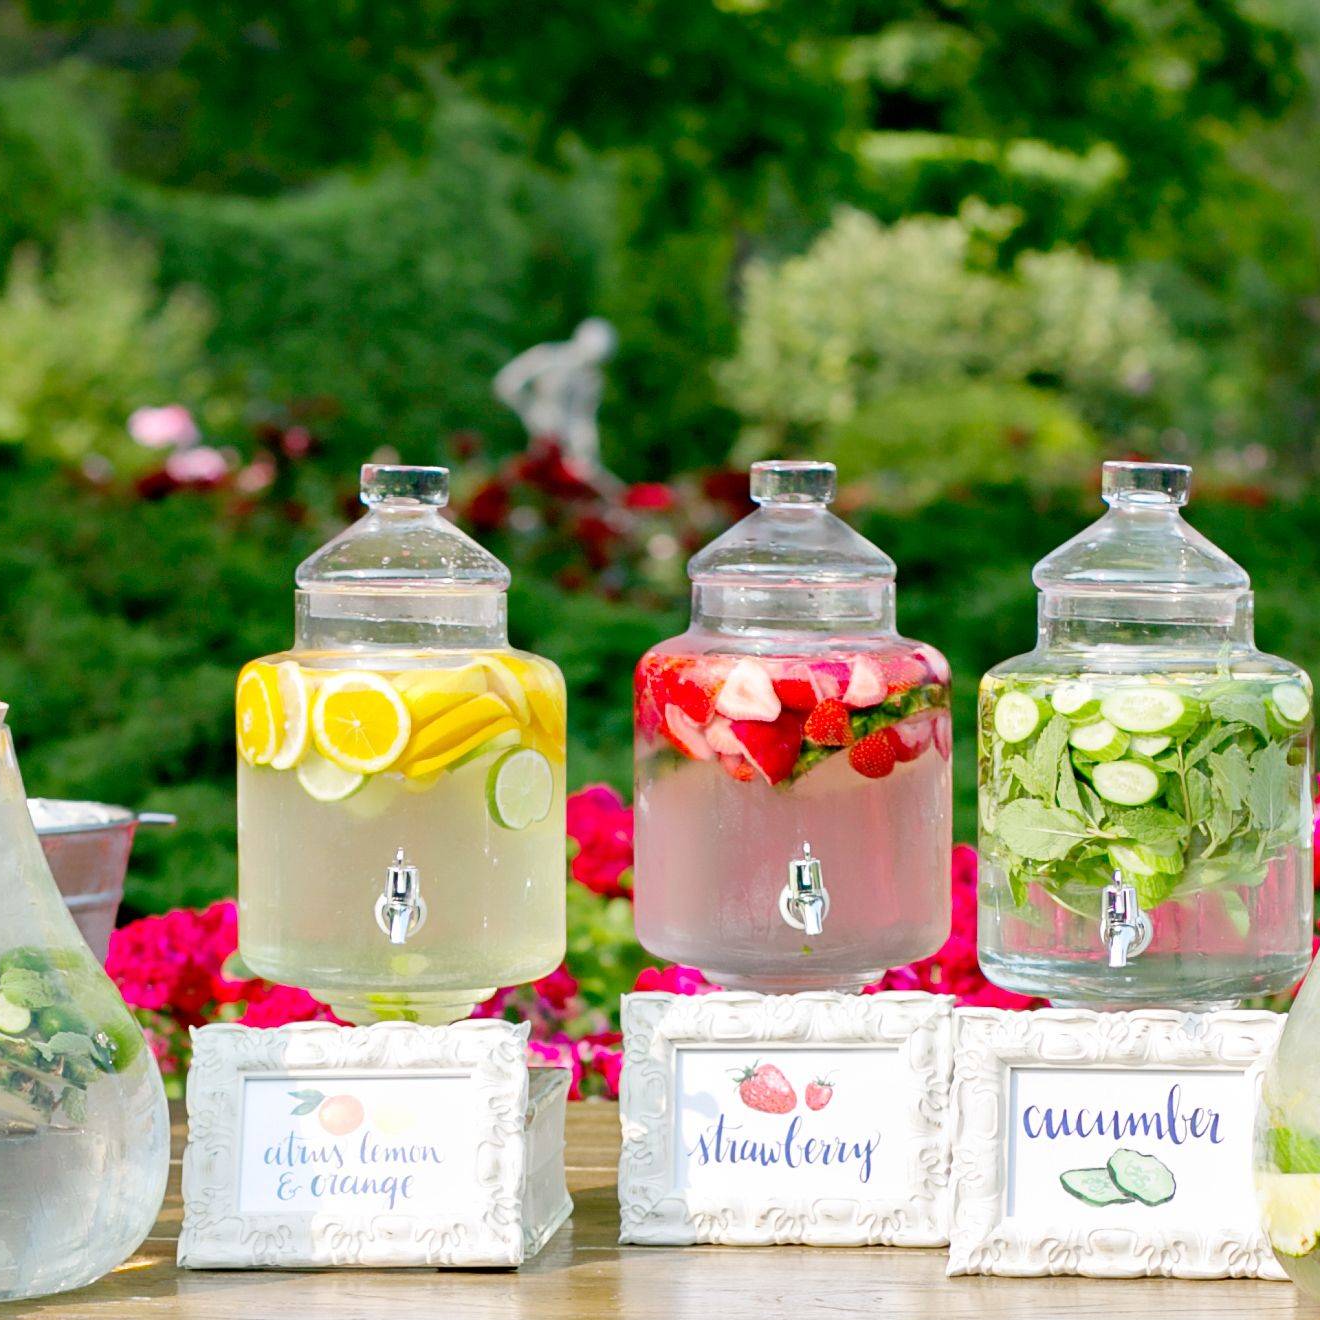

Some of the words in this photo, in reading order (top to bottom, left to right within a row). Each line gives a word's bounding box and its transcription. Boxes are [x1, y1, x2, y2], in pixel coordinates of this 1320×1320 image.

[1022, 1083, 1224, 1145] cucumber
[263, 1130, 344, 1168] citrus
[360, 1131, 445, 1164] lemon
[688, 1113, 881, 1183] strawberry
[277, 1171, 302, 1201] &
[310, 1172, 415, 1210] orange
